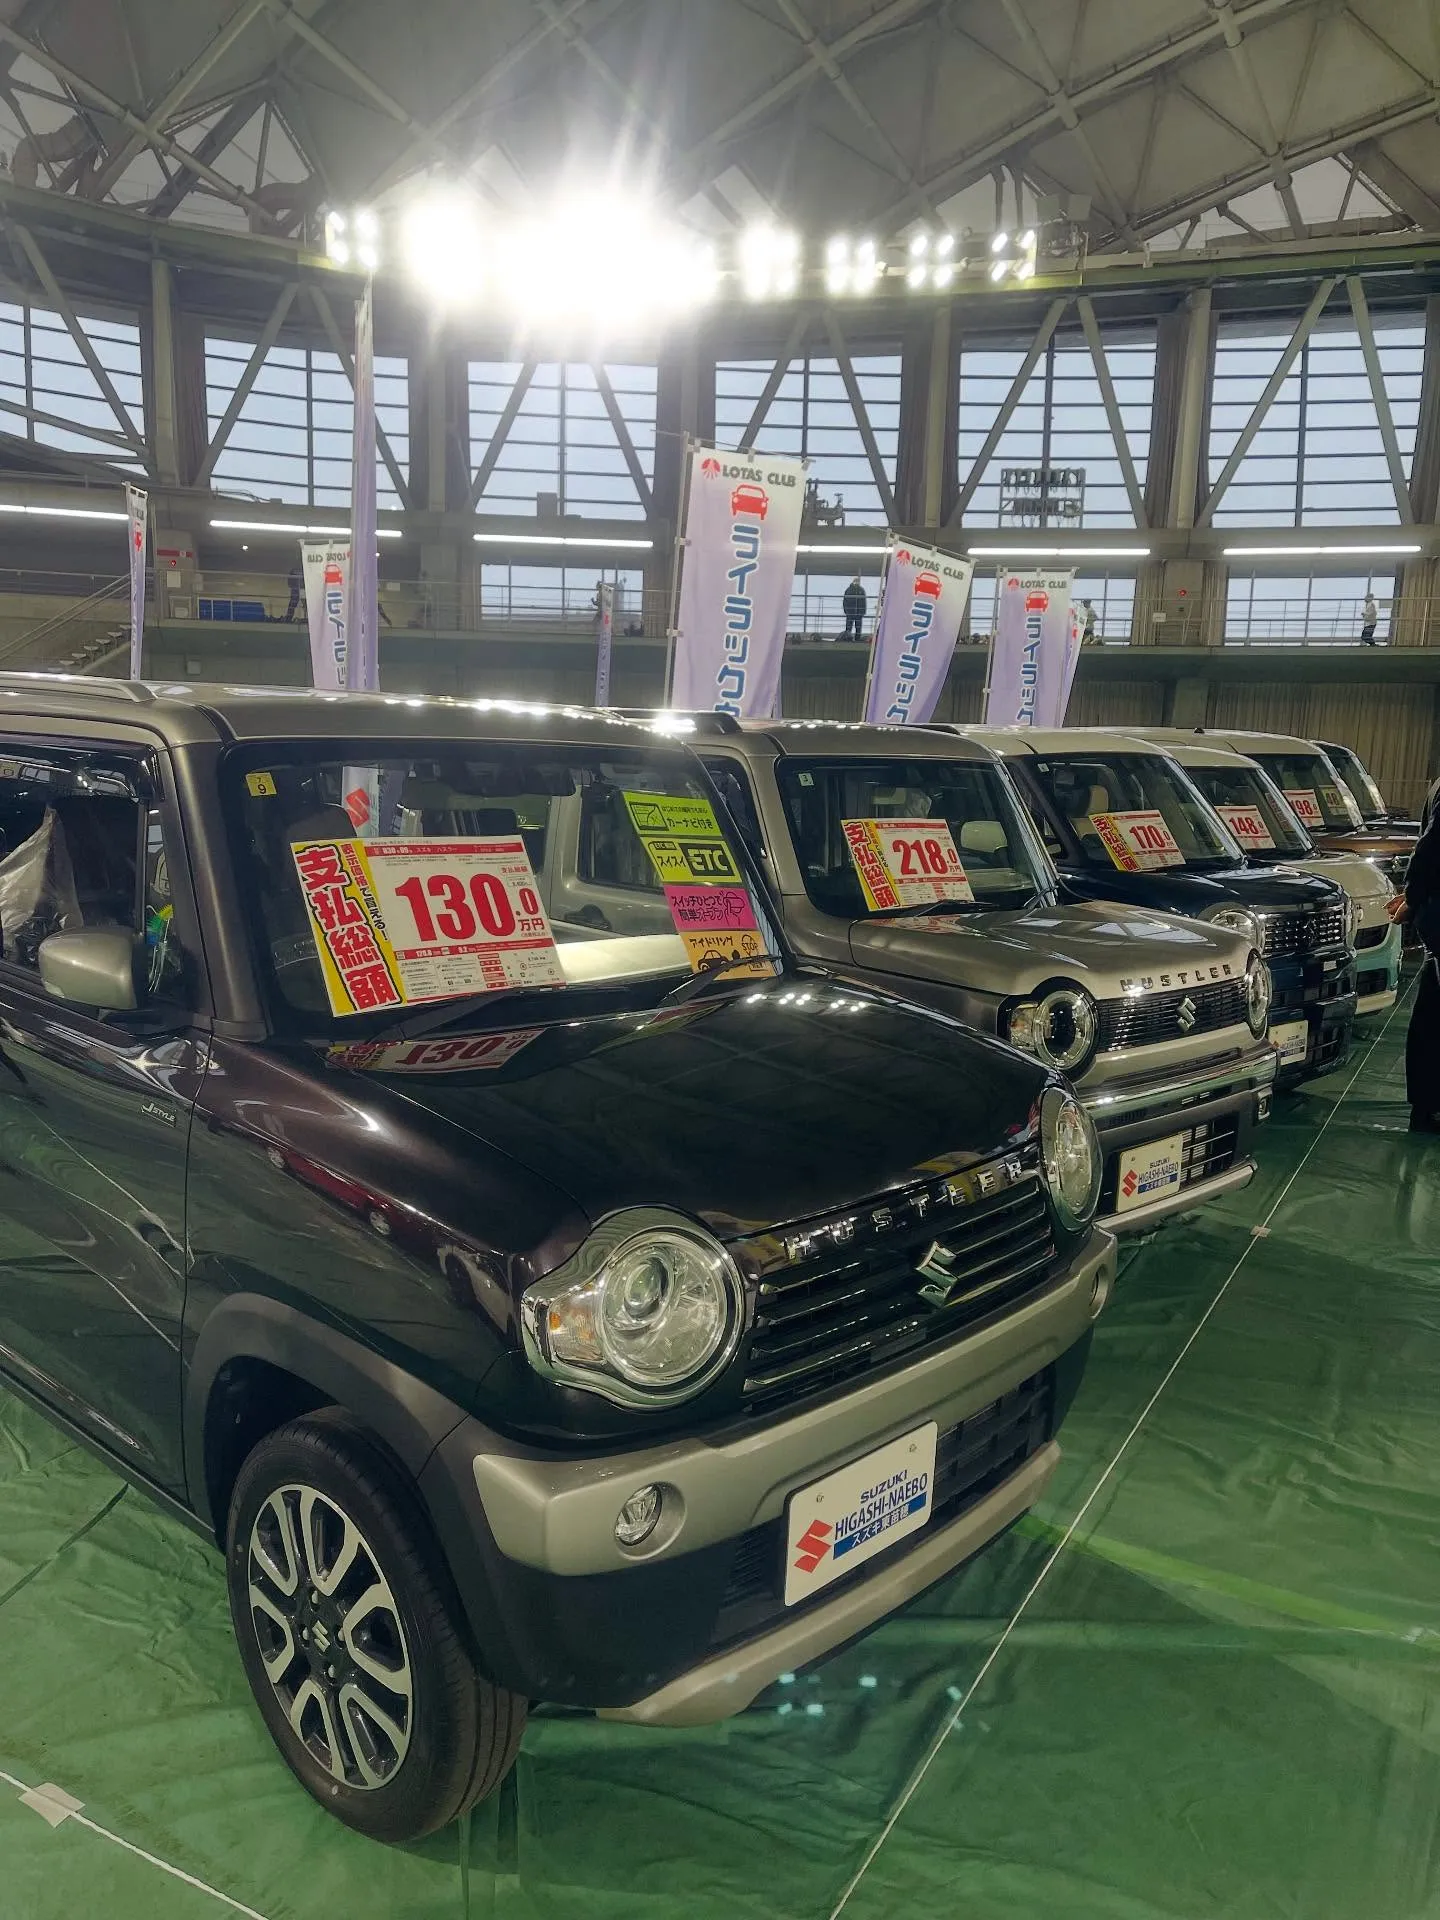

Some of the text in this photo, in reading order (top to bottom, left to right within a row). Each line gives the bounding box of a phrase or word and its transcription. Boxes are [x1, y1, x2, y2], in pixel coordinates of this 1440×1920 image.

[722, 464, 797, 488] LOTAS CLUB
[911, 556, 965, 581] LOTAS CLUB
[1020, 579, 1067, 589] LOTAS CLUB
[257, 784, 267, 794] 9
[666, 817, 713, 830] カーナビ付き
[657, 856, 686, 867] スイスイ
[687, 848, 729, 871] ETC
[844, 823, 897, 909] 支払総額
[671, 895, 722, 908] スイッチひとつで
[296, 845, 399, 1010] 支払総額
[518, 917, 546, 932] 万円
[689, 936, 734, 948] アイドリング
[1119, 963, 1233, 992] HUSTLER
[860, 1469, 908, 1505] SUZUKI
[834, 1472, 928, 1540] HIGASHI-NAEBO
